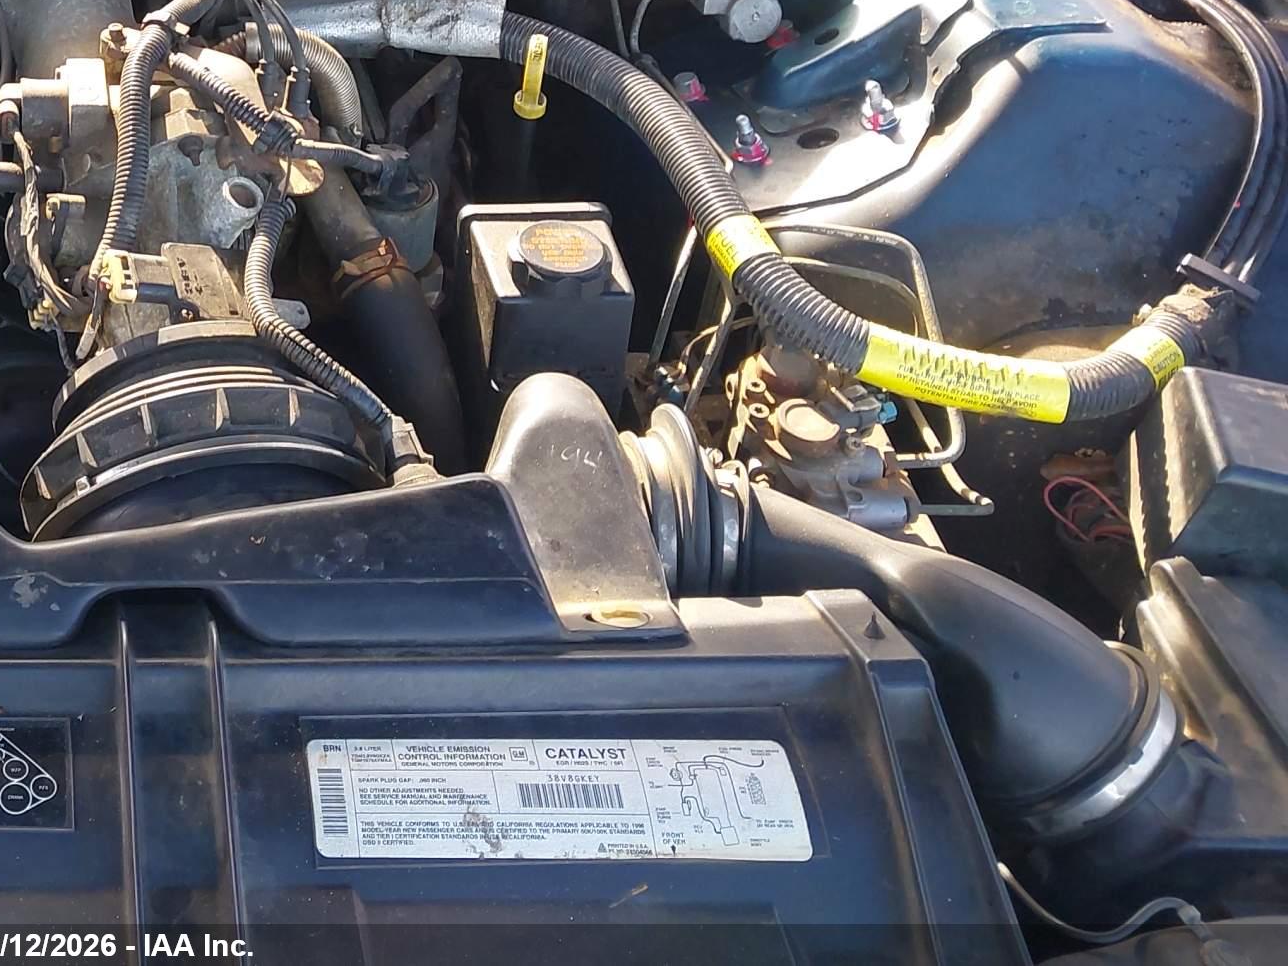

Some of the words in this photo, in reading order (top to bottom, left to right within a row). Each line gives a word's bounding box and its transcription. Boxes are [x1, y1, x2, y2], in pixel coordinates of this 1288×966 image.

[716, 229, 738, 263] FUEL
[914, 386, 958, 402] POTENTIAL
[979, 394, 990, 402] TO
[1013, 399, 1038, 408] AVOID
[546, 748, 626, 759] CATALYST
